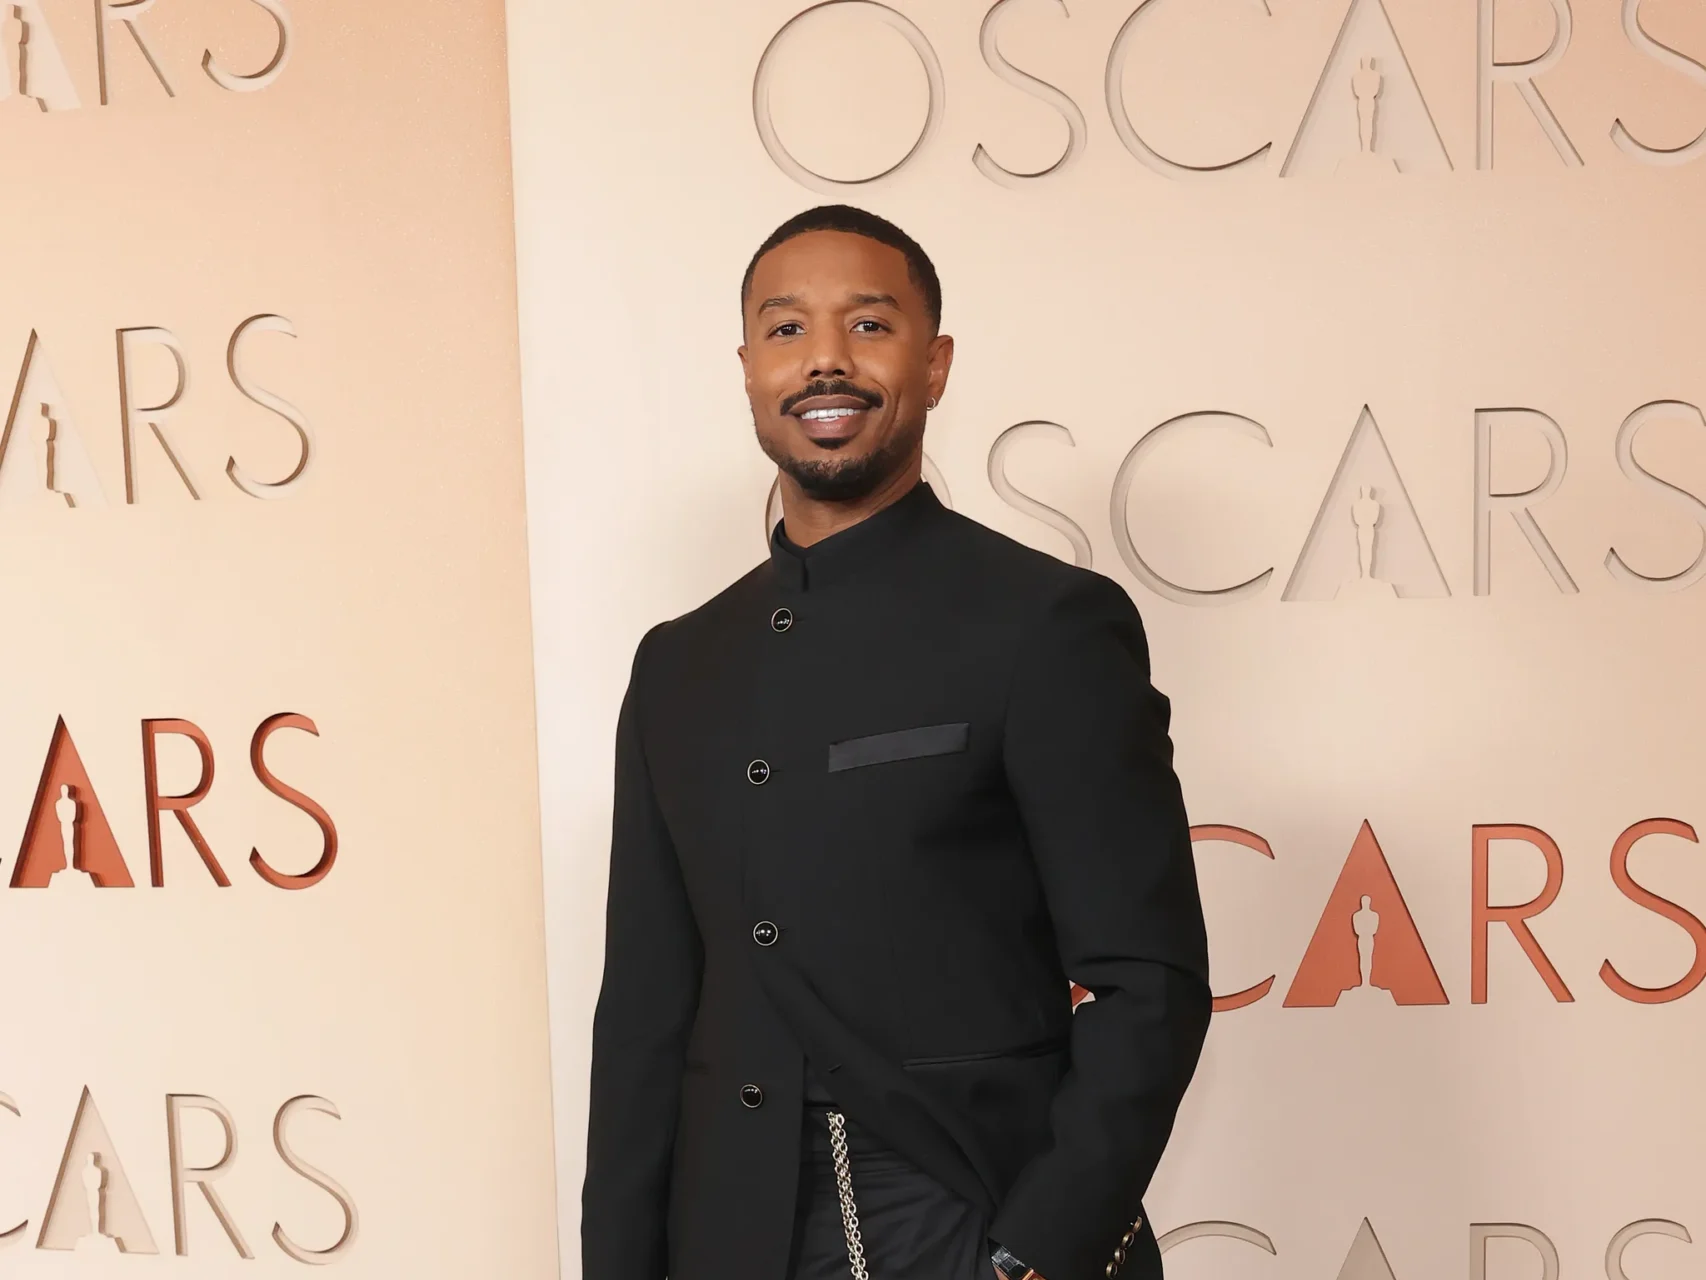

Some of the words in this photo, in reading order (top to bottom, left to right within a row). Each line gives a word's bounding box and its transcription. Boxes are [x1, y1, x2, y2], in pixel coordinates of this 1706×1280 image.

[752, 0, 1706, 196] OSCARS
[0, 313, 314, 508] ARS
[765, 401, 1706, 607] SCARS
[9, 712, 338, 890] ARS
[0, 1084, 359, 1265] ARS
